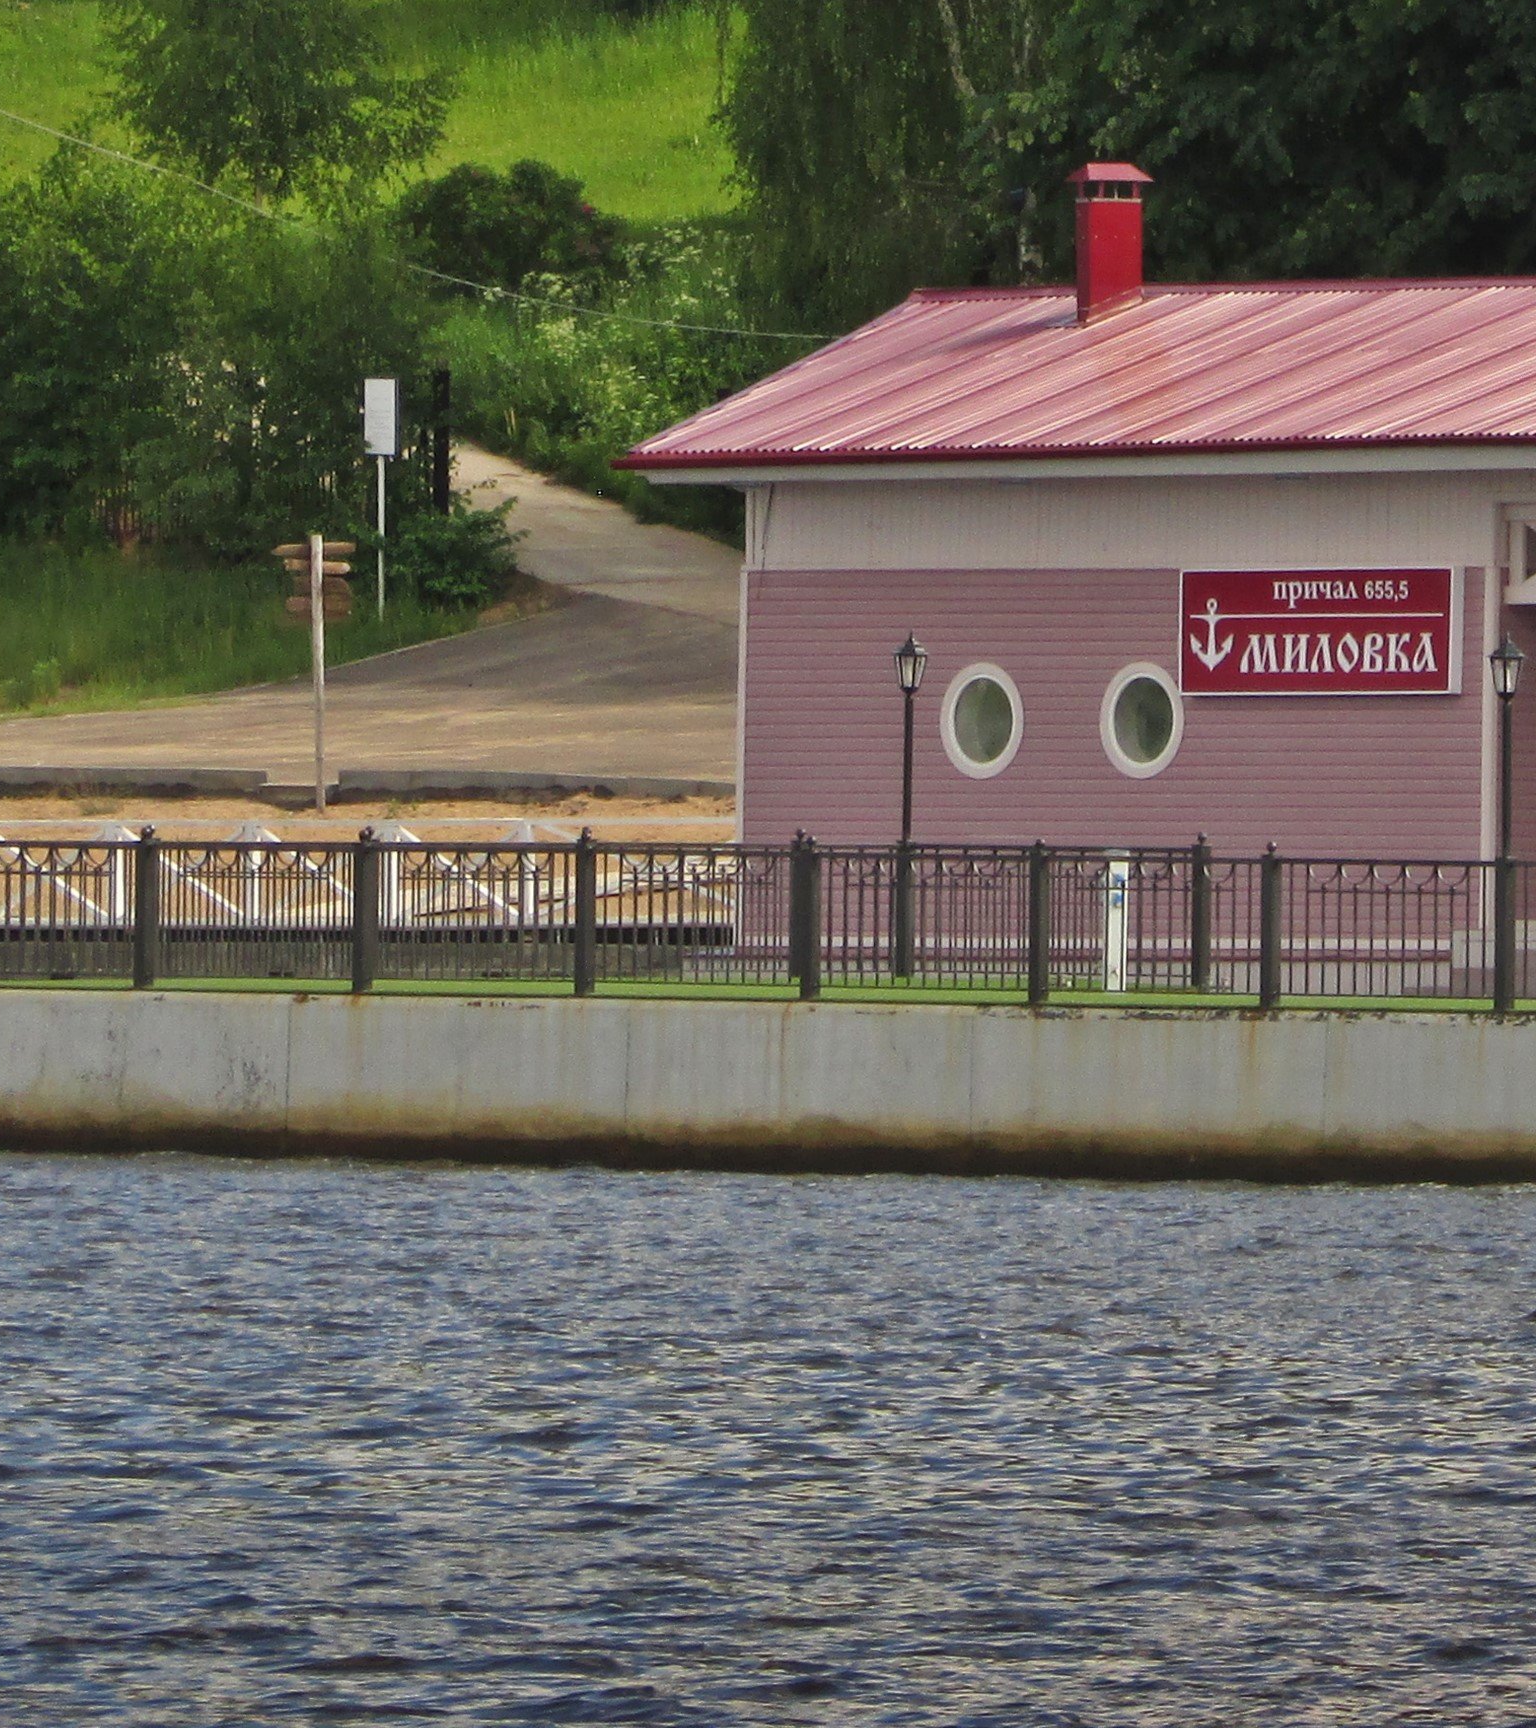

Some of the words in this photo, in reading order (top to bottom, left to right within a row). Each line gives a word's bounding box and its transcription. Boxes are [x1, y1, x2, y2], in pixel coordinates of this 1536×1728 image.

[1274, 581, 1357, 608] причал
[1365, 581, 1408, 600] 655,5
[1240, 633, 1437, 672] МИЛОВКА
